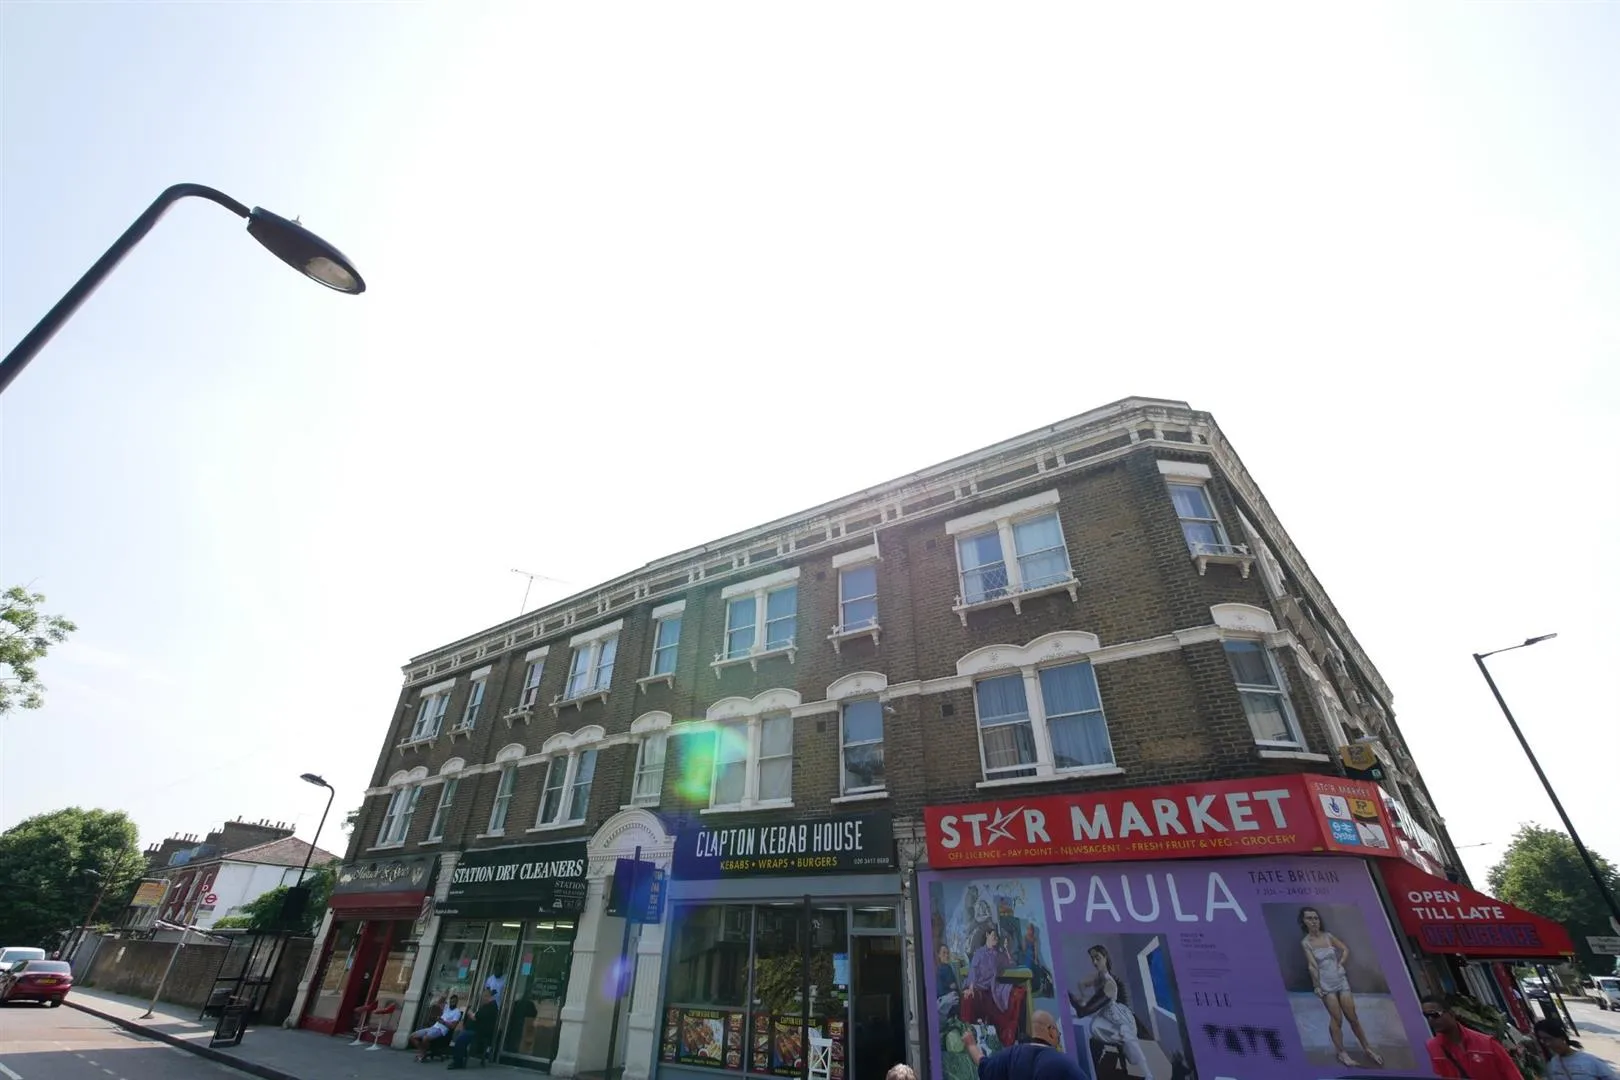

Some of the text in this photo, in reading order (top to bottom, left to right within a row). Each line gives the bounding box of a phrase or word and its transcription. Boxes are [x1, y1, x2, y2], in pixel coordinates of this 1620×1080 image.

[1070, 789, 1291, 841] MARKET
[696, 820, 863, 857] CLAPTON KEBAB HOUSE
[966, 850, 1001, 860] LICENCE
[1008, 848, 1022, 857] PAY
[1024, 847, 1053, 857] POINT
[1061, 844, 1121, 855] NEWSAGENT
[1132, 842, 1164, 851] FRESH
[1166, 839, 1197, 849] FRUIT
[1200, 839, 1207, 848] &
[1241, 834, 1297, 846] GROCERY
[453, 858, 584, 884] STATION DRY CLEANERS
[720, 856, 838, 870] KEBABS WRAPS BURGERS
[554, 880, 586, 889] STATION
[1248, 870, 1339, 883] TATE BRITAIN
[1050, 872, 1248, 922] PAULA
[1408, 891, 1461, 903] OPEN
[1412, 906, 1505, 920] TILL LATE
[1423, 924, 1541, 947] OFF LICENCE
[1194, 991, 1232, 1008] ELLE
[1201, 1024, 1288, 1063] TATE
